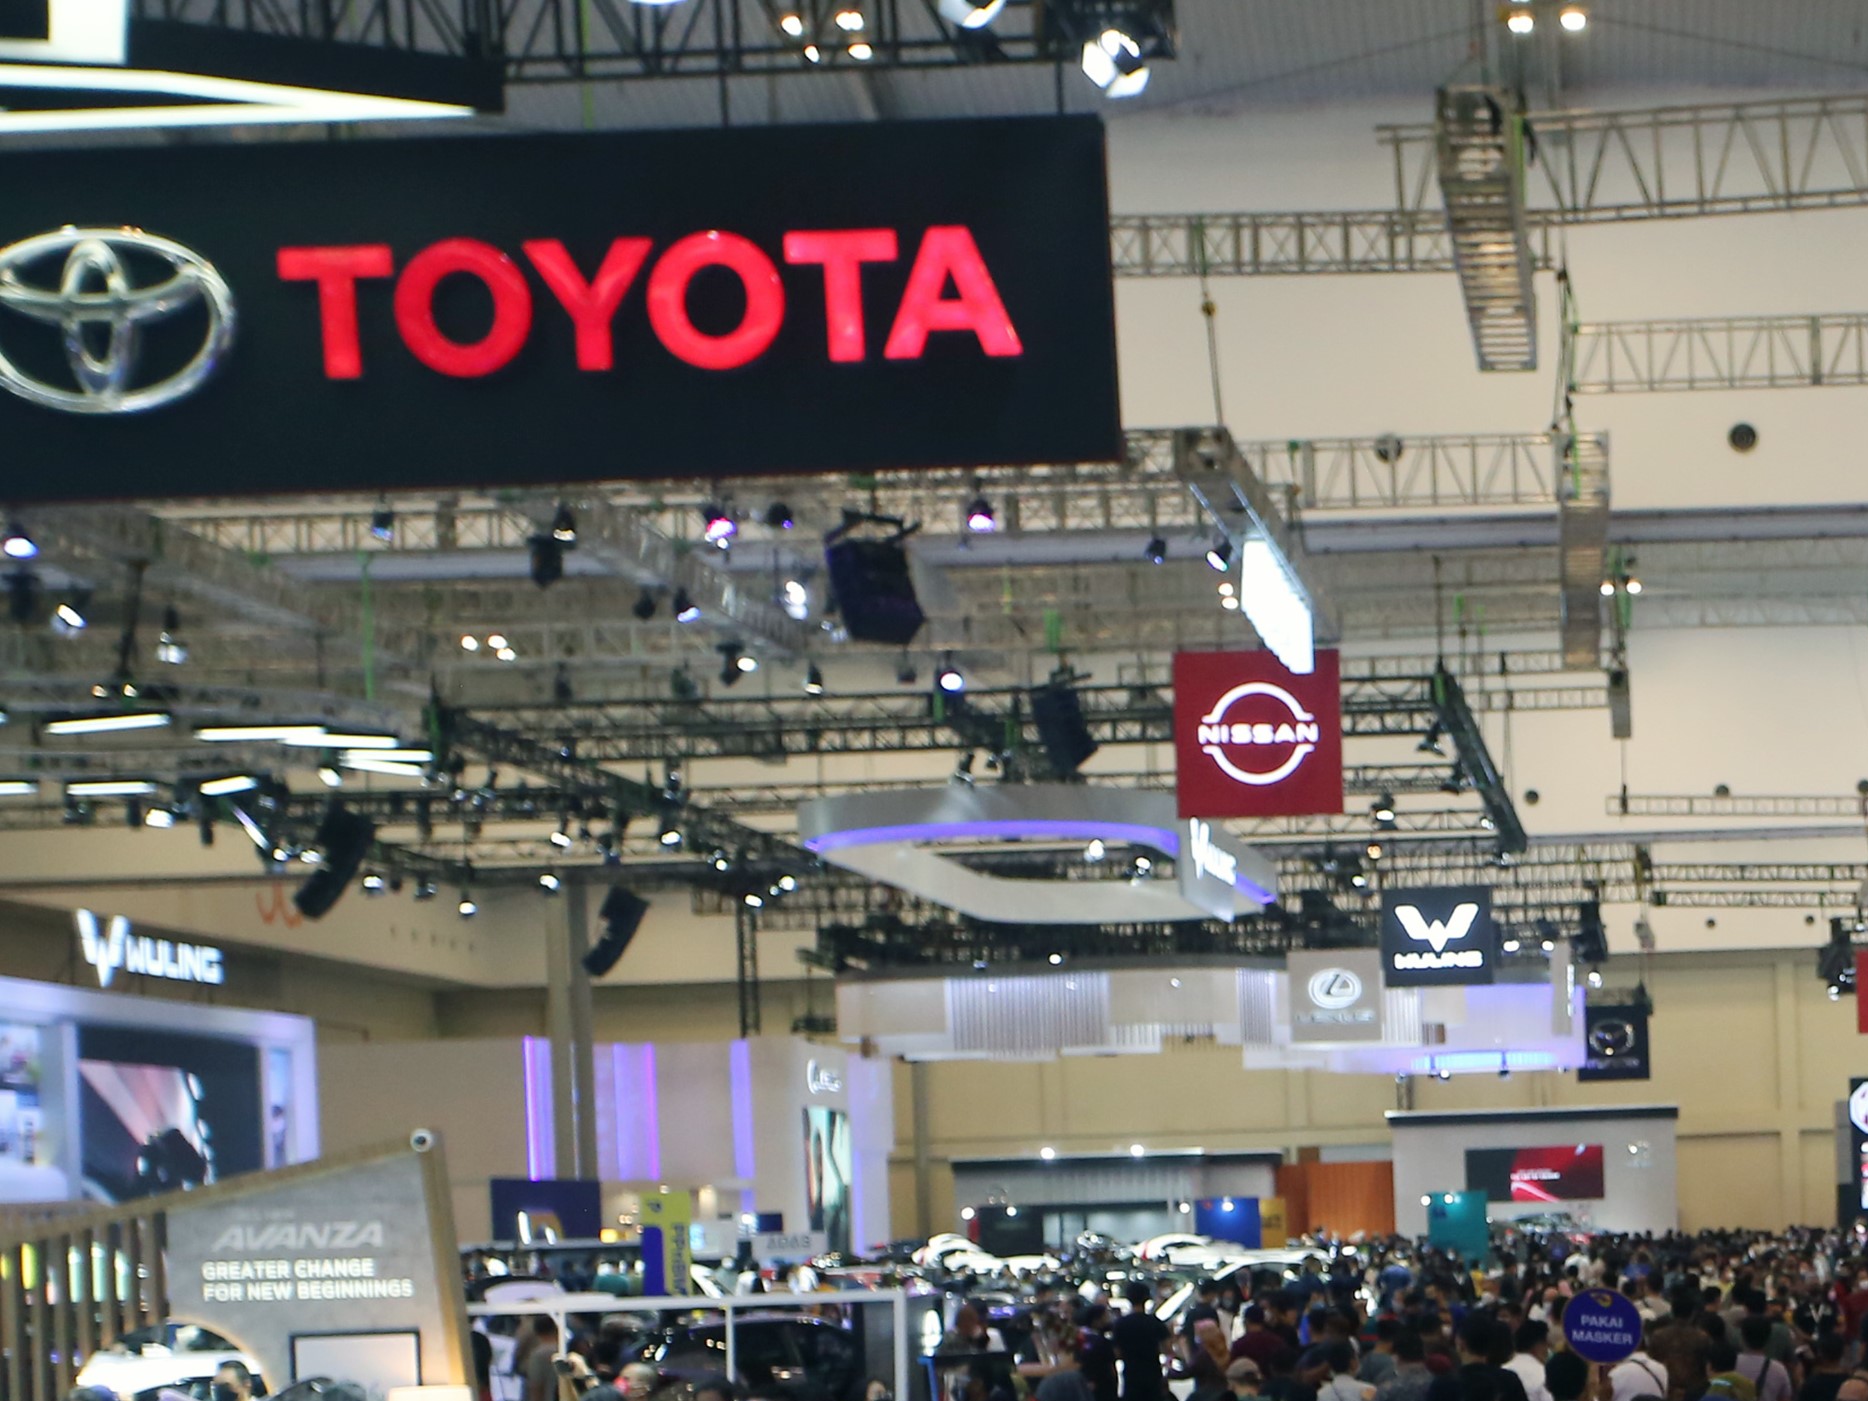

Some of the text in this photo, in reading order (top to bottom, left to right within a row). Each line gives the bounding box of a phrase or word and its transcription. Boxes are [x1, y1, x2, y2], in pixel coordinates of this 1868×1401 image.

[277, 225, 1023, 379] TOYOTA
[1197, 723, 1320, 745] NISSAN
[211, 1220, 384, 1252] AVANZA
[202, 1257, 376, 1281] GREATER CHANGE
[203, 1277, 415, 1302] FOR NEW BEGINNINGS
[1580, 1314, 1624, 1329] PAKAI
[1571, 1330, 1634, 1345] MASKER
